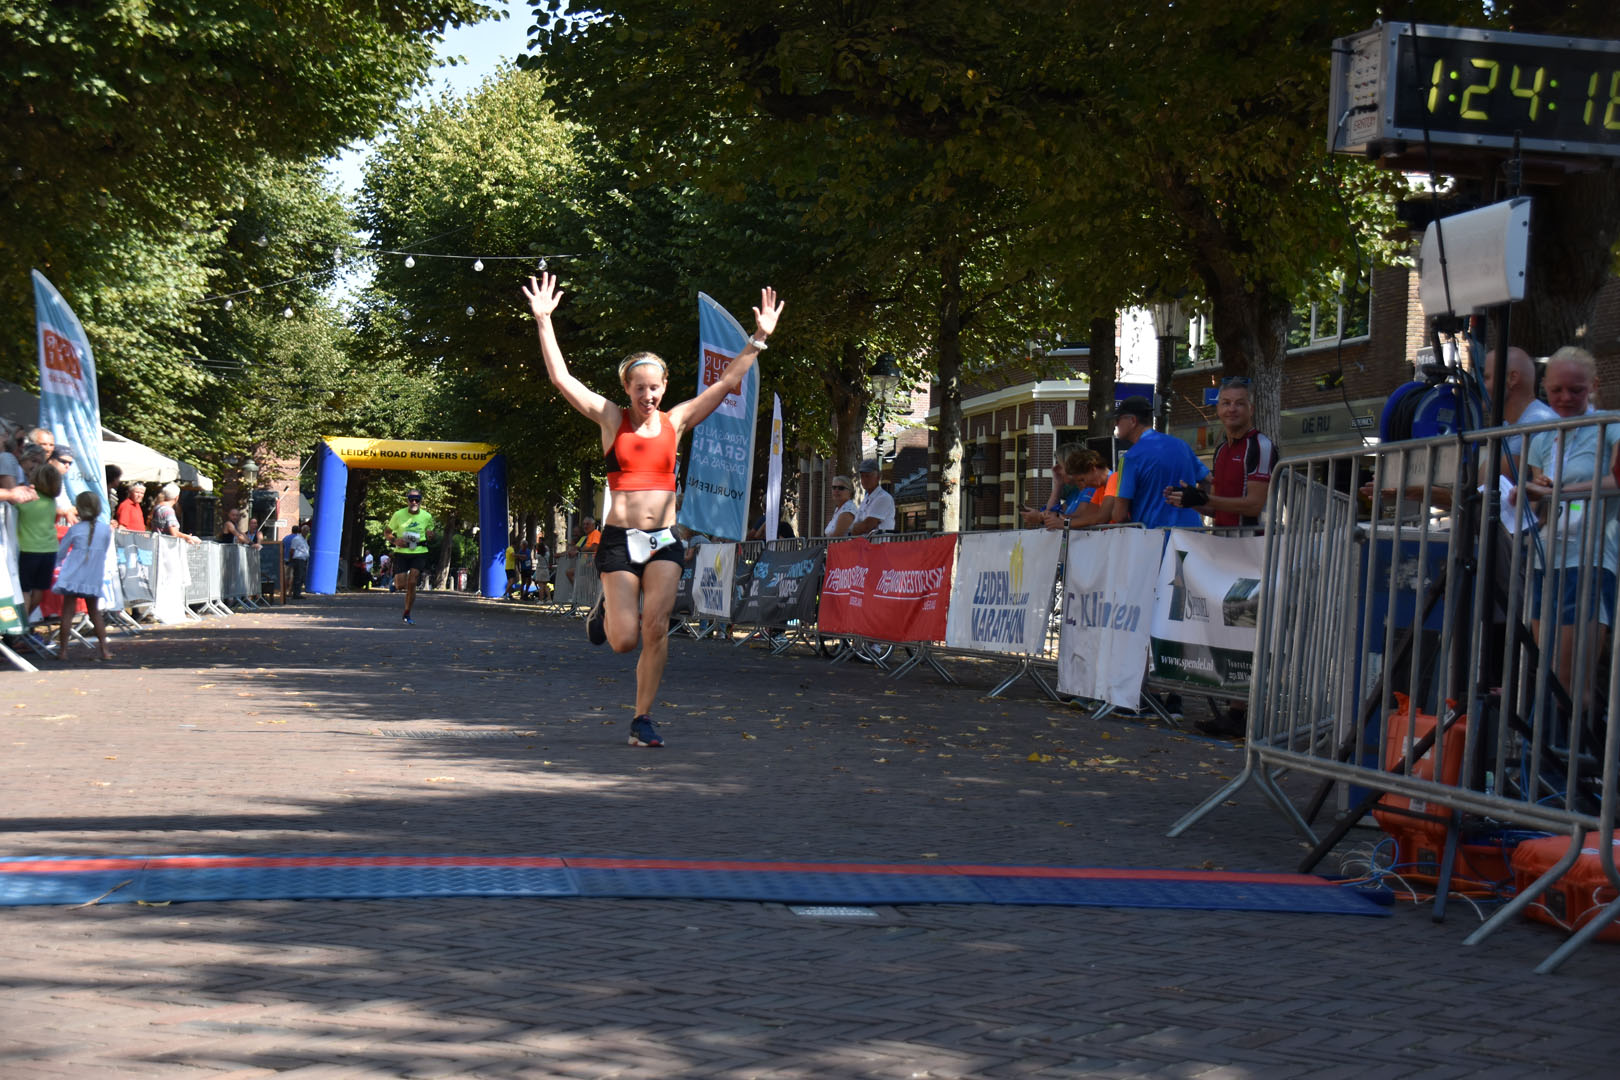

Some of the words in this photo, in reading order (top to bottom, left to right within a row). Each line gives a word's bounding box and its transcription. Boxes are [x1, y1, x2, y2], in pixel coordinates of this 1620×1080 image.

[340, 449, 377, 457] LEIDEN
[380, 450, 407, 459] ROAD
[410, 451, 458, 460] RUNNERS
[460, 452, 487, 461] CLUB
[649, 536, 658, 550] 9
[973, 571, 1009, 605] LEIDEN
[972, 607, 1026, 644] MARATHON
